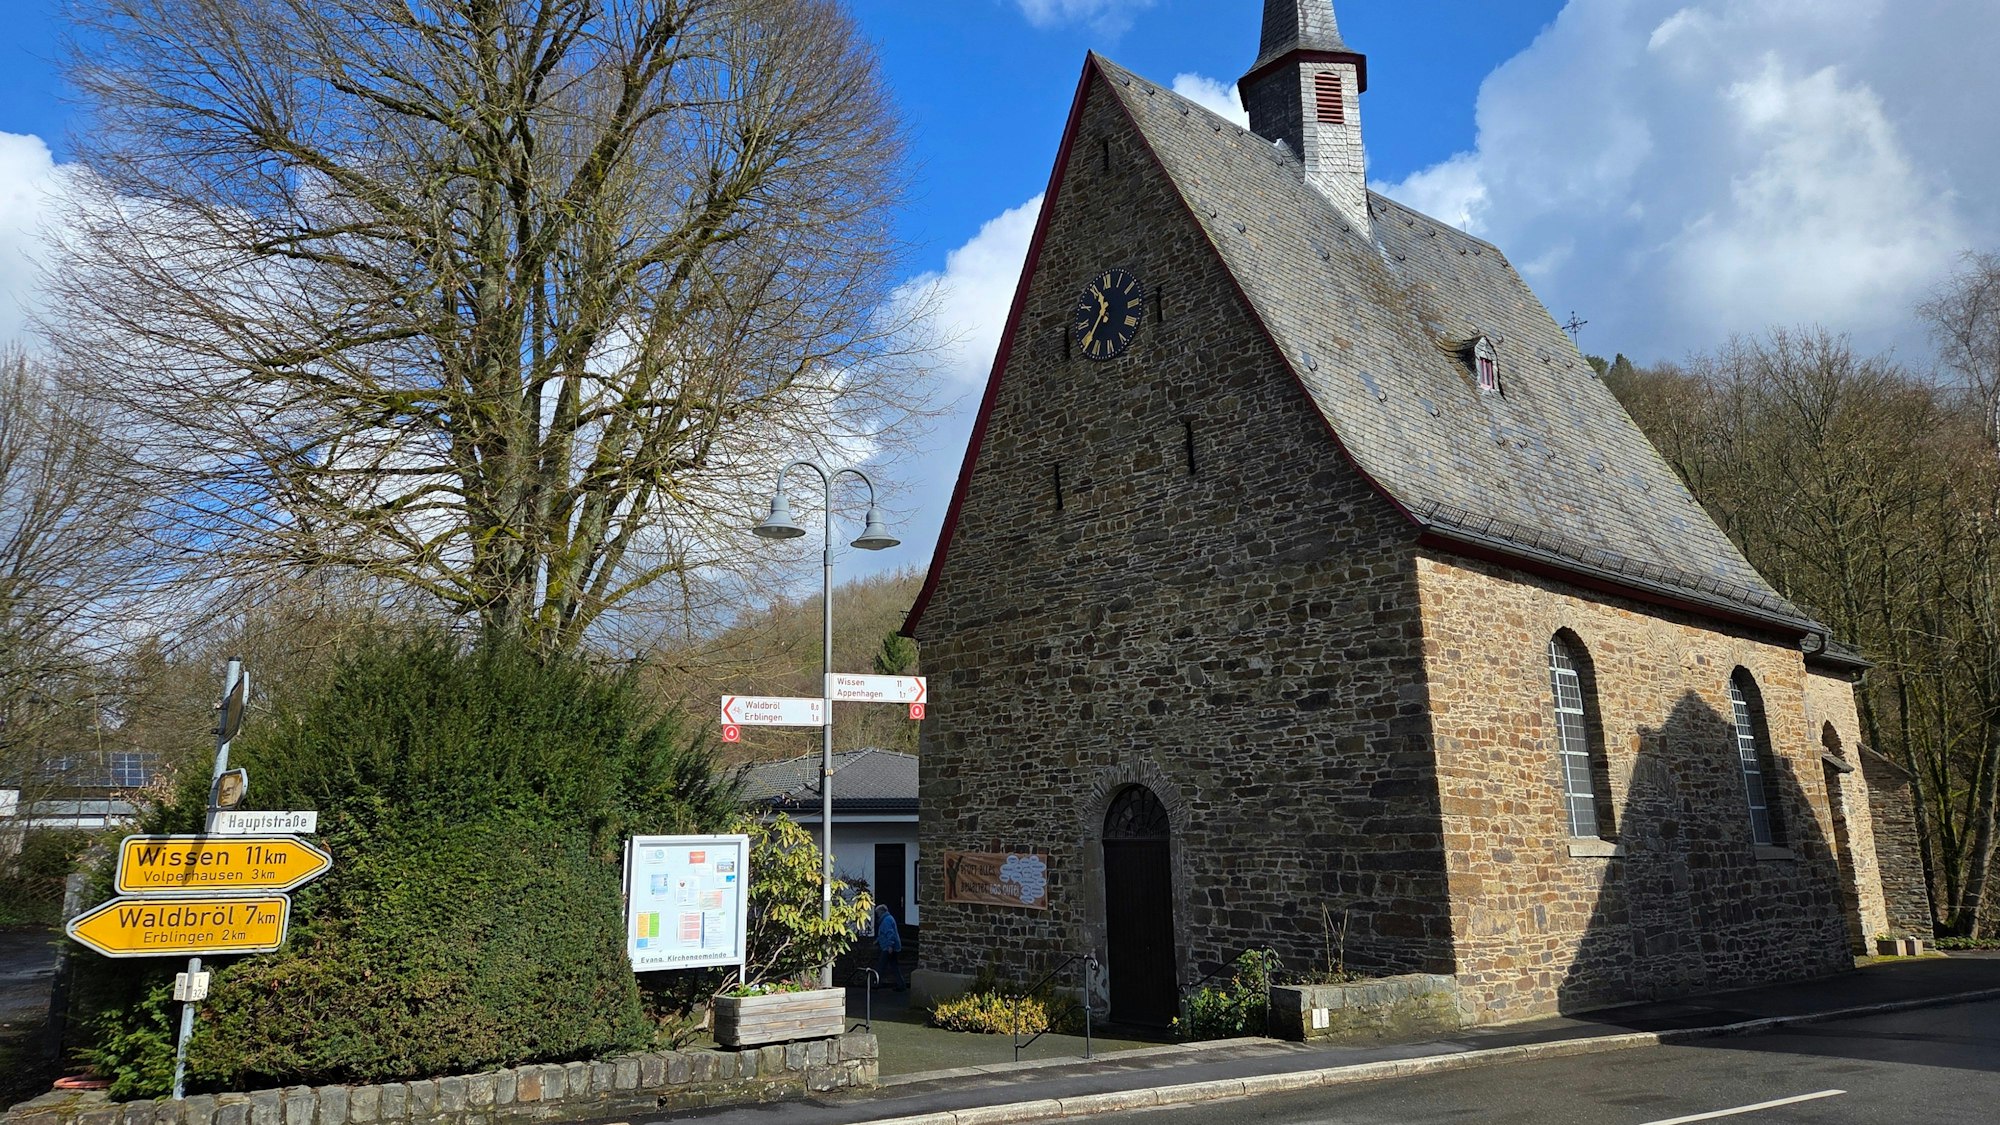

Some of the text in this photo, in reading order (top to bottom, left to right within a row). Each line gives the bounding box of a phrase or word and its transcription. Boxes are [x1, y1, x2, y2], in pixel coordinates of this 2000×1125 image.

[837, 677, 865, 686] Wissen
[837, 689, 883, 699] Appenhagen
[745, 701, 781, 710] Waldbröl
[744, 712, 783, 722] Erblingen
[229, 814, 308, 831] Hauptstraße
[136, 846, 230, 867] Wissen
[143, 869, 243, 885] Volperhausen
[118, 905, 234, 929] Waldbröl
[143, 931, 214, 945] Erblingen
[667, 952, 727, 962] Kirchengemeinde
